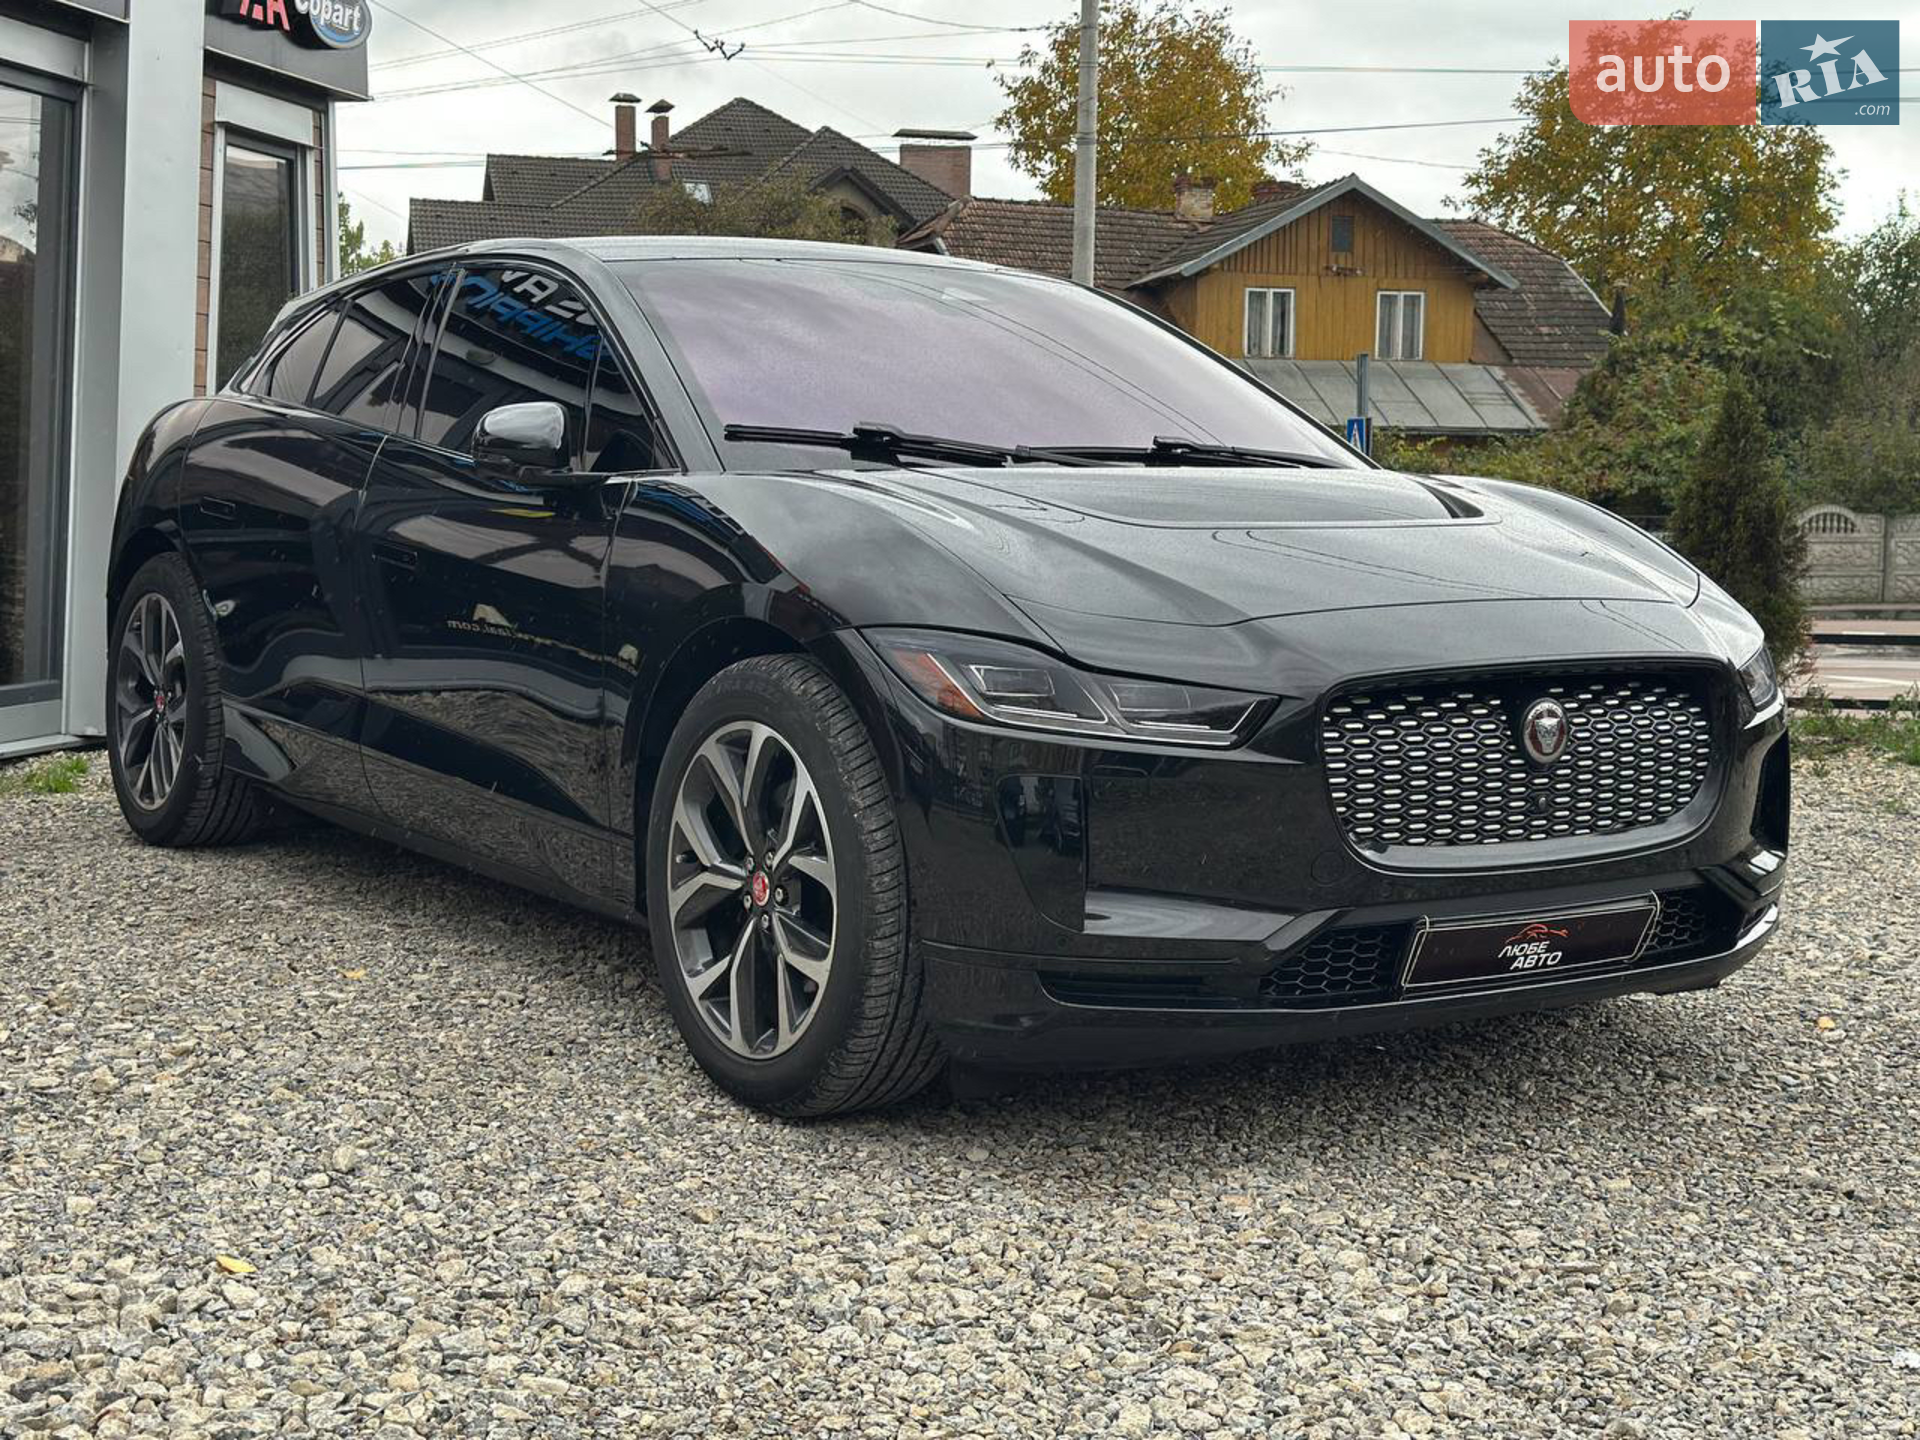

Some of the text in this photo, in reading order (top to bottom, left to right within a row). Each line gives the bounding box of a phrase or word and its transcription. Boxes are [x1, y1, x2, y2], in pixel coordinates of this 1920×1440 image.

[294, 0, 361, 35] Copart
[1497, 940, 1550, 958] ЛЮБЕ
[1509, 950, 1563, 970] АВТО
